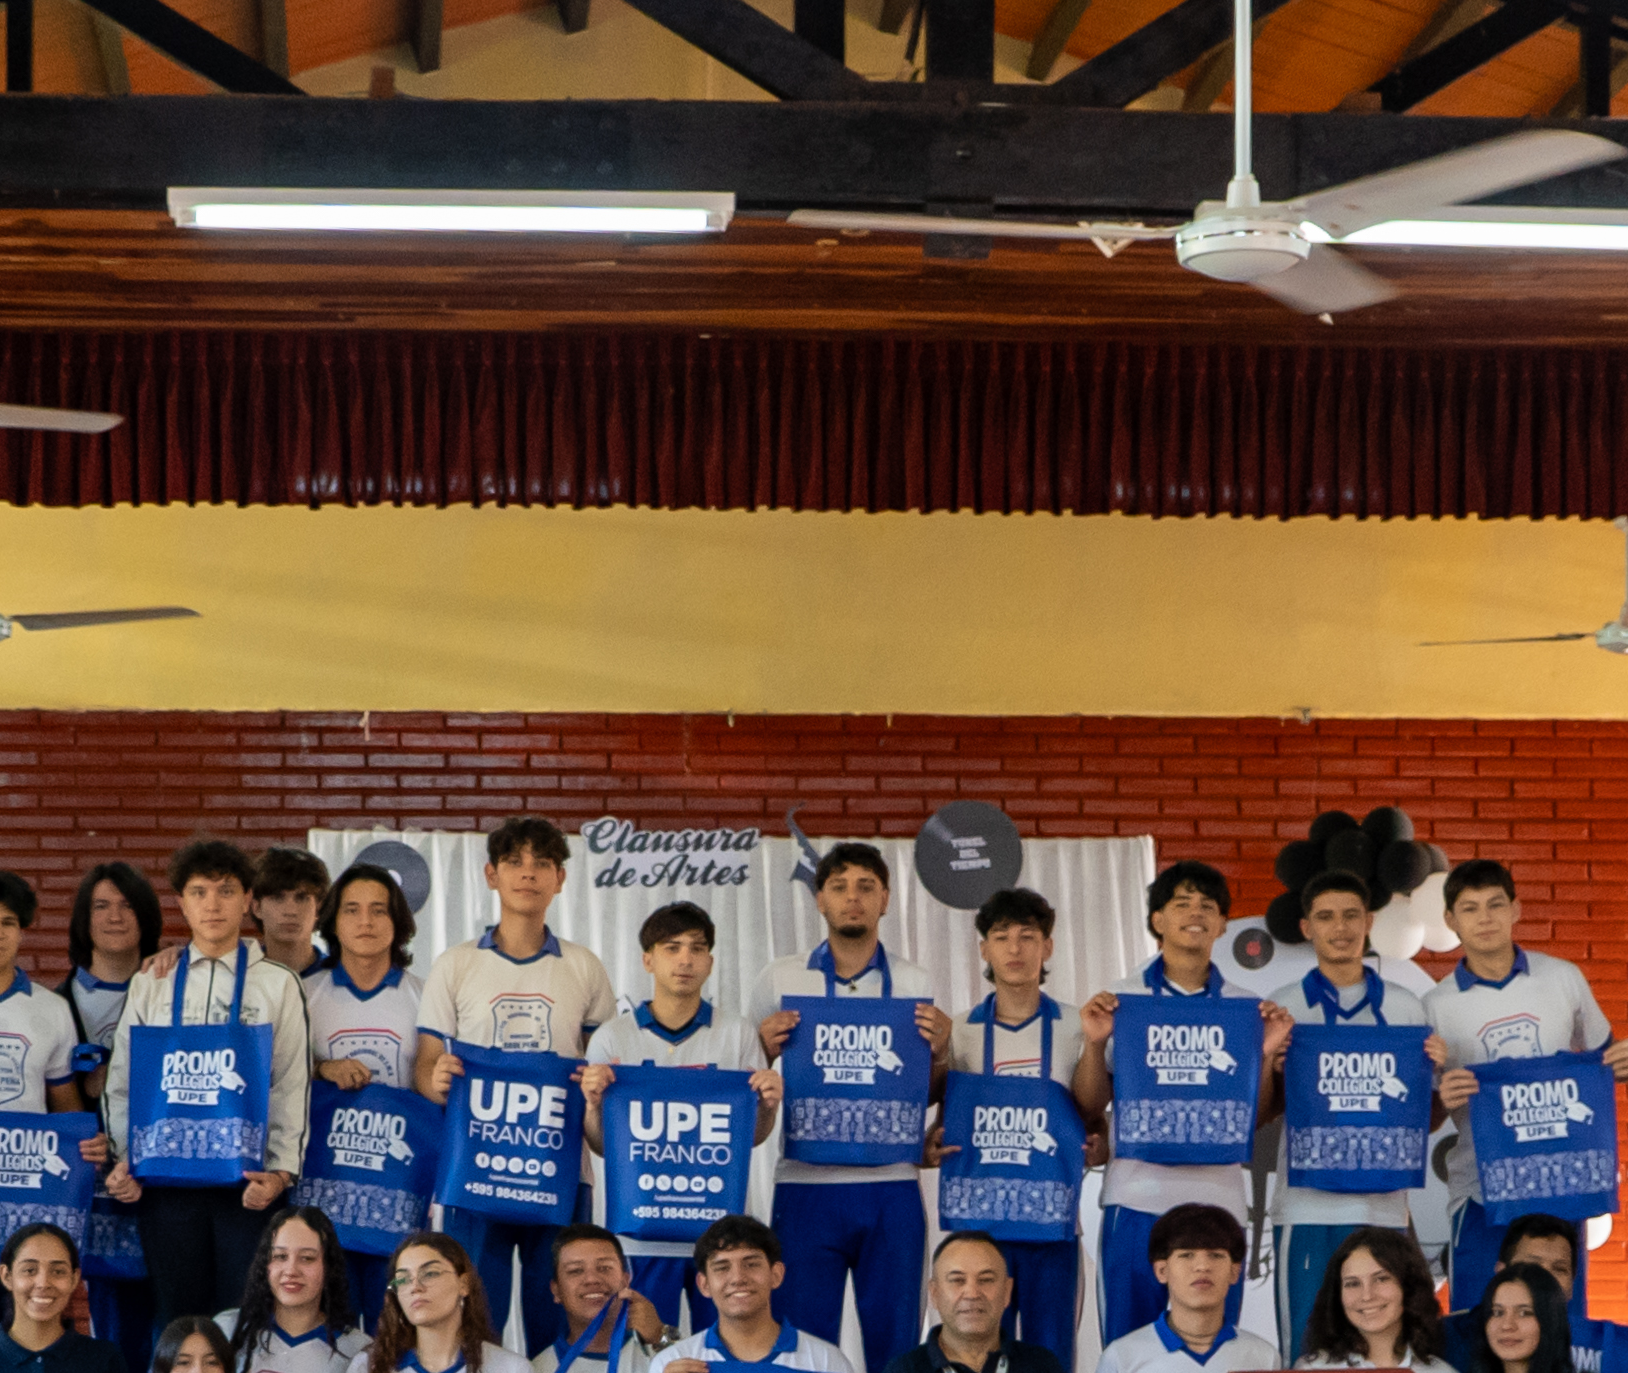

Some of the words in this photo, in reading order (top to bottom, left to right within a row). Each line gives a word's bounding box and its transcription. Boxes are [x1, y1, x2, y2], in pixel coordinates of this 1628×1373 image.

[586, 820, 759, 854] Clausura
[594, 857, 636, 888] de
[641, 855, 749, 887] Artes
[815, 1024, 892, 1051] PROMO
[1148, 1024, 1224, 1051] PROMO
[163, 1049, 236, 1075] PROMO
[1319, 1052, 1396, 1079] PROMO
[834, 1071, 863, 1082] UPE
[1166, 1071, 1197, 1083] UPE
[178, 1092, 208, 1103] UPE
[470, 1079, 567, 1129] UPE
[1339, 1096, 1369, 1109] UPE
[1502, 1078, 1579, 1110] PROMO
[331, 1108, 406, 1140] PROMO
[629, 1100, 731, 1144] UPE
[974, 1106, 1047, 1133] PROMO
[1526, 1123, 1557, 1137] UPE
[469, 1120, 564, 1150] FRANCO
[343, 1153, 373, 1167] UPE
[630, 1143, 731, 1166] FRANCO
[989, 1150, 1019, 1162] UPE
[0, 1174, 30, 1186] UPE
